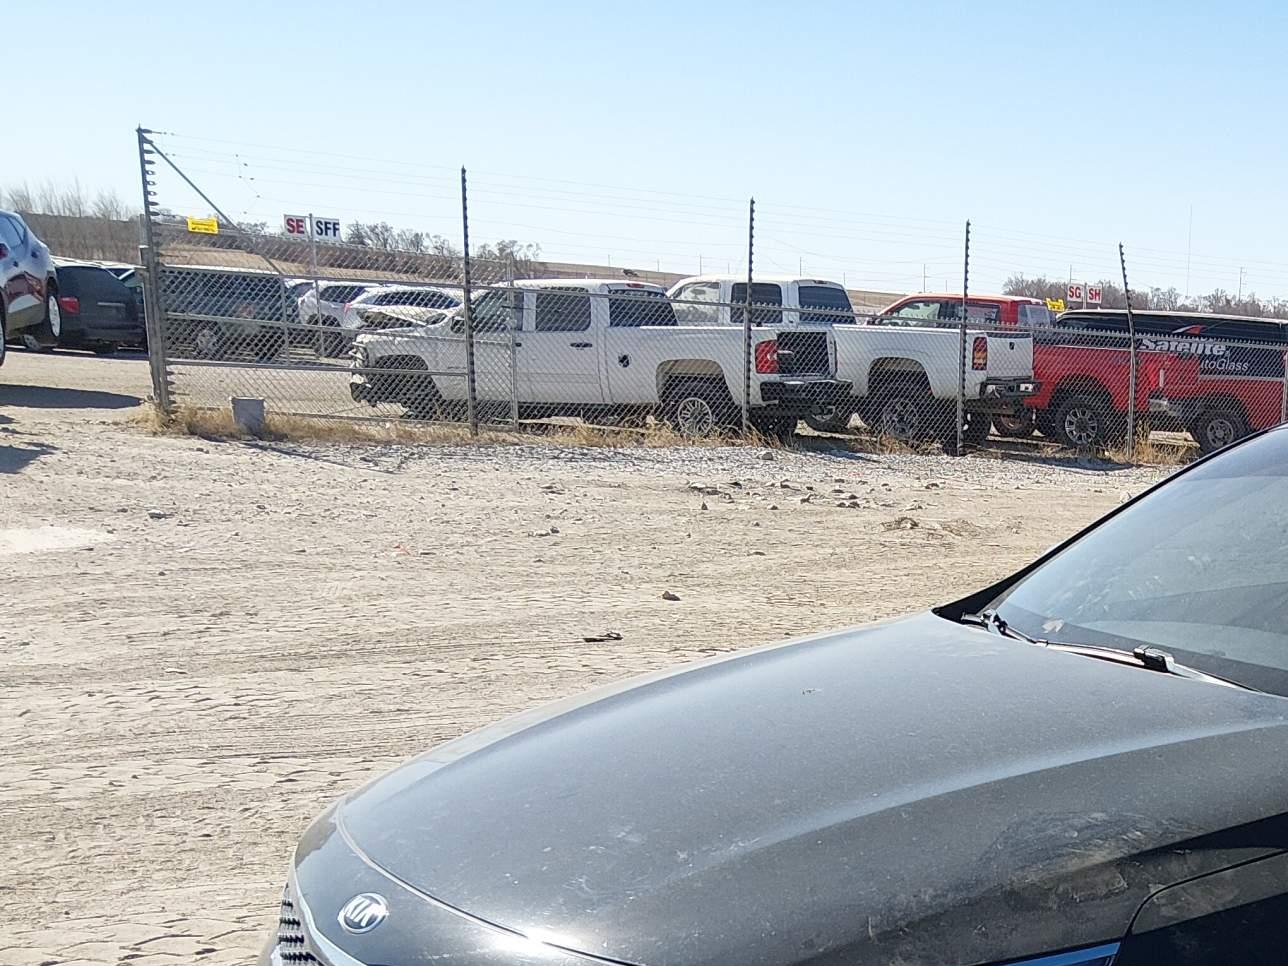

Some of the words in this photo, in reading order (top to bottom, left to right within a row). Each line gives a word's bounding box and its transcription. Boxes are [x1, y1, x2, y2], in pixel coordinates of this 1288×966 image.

[286, 218, 305, 234] SE
[315, 220, 340, 237] SFF
[1069, 286, 1081, 298] SG
[1088, 288, 1101, 301] SH
[343, 894, 384, 928] KIA
